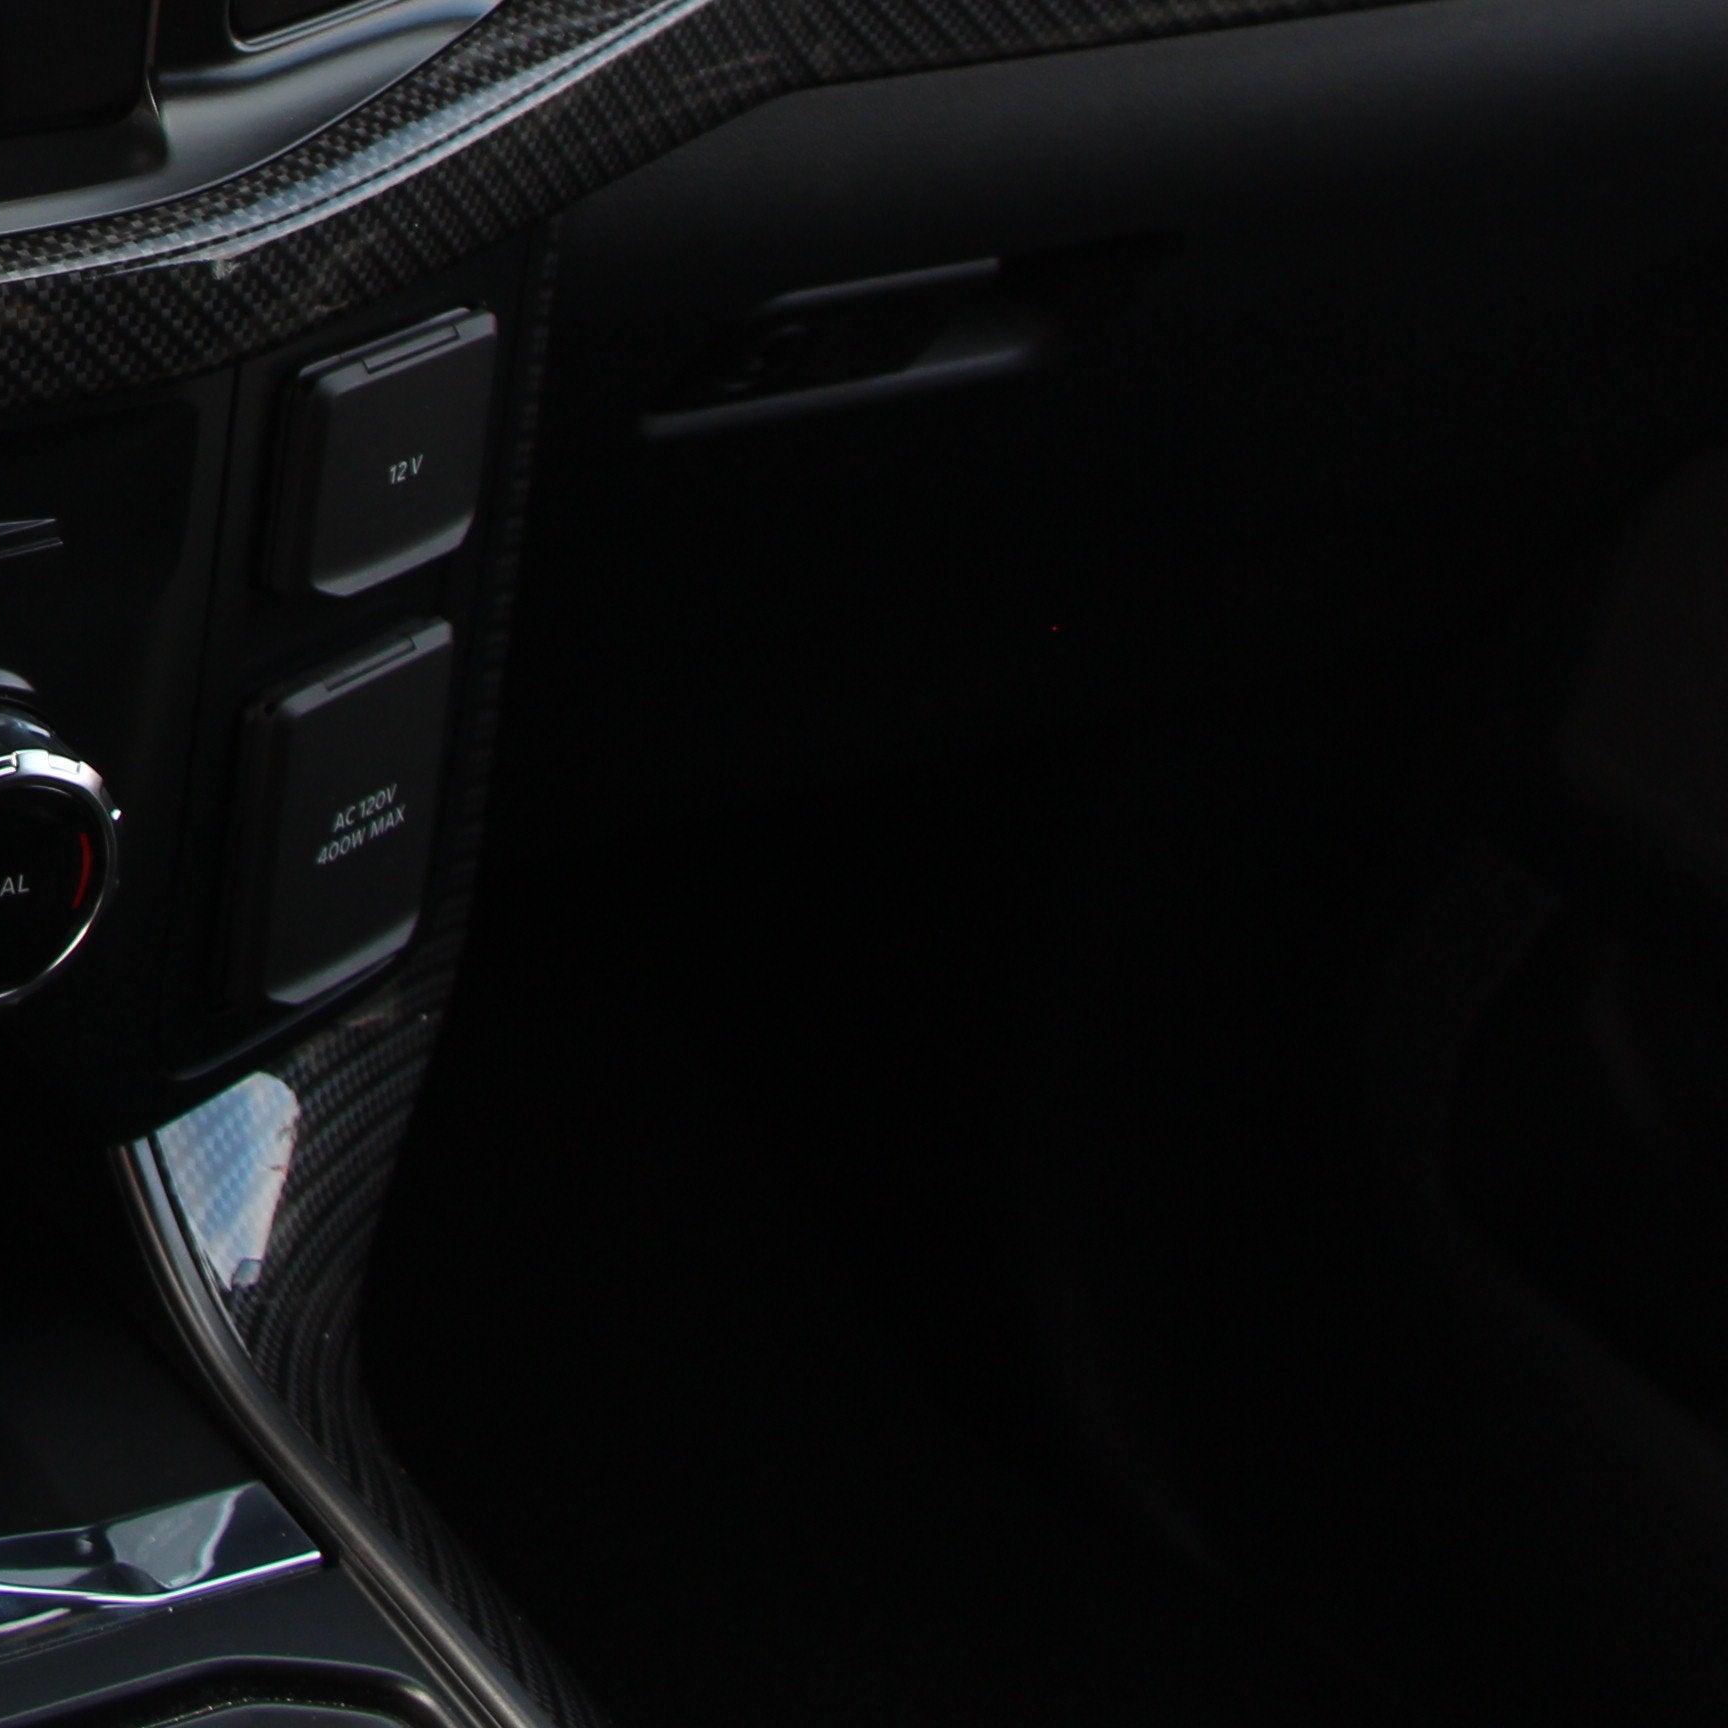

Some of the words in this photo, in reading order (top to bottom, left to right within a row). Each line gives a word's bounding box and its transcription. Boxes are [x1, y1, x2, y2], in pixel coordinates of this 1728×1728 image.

[315, 827, 365, 865] 400W
[369, 804, 406, 840] MAX
[332, 804, 355, 833] AC
[359, 782, 398, 818] 120V
